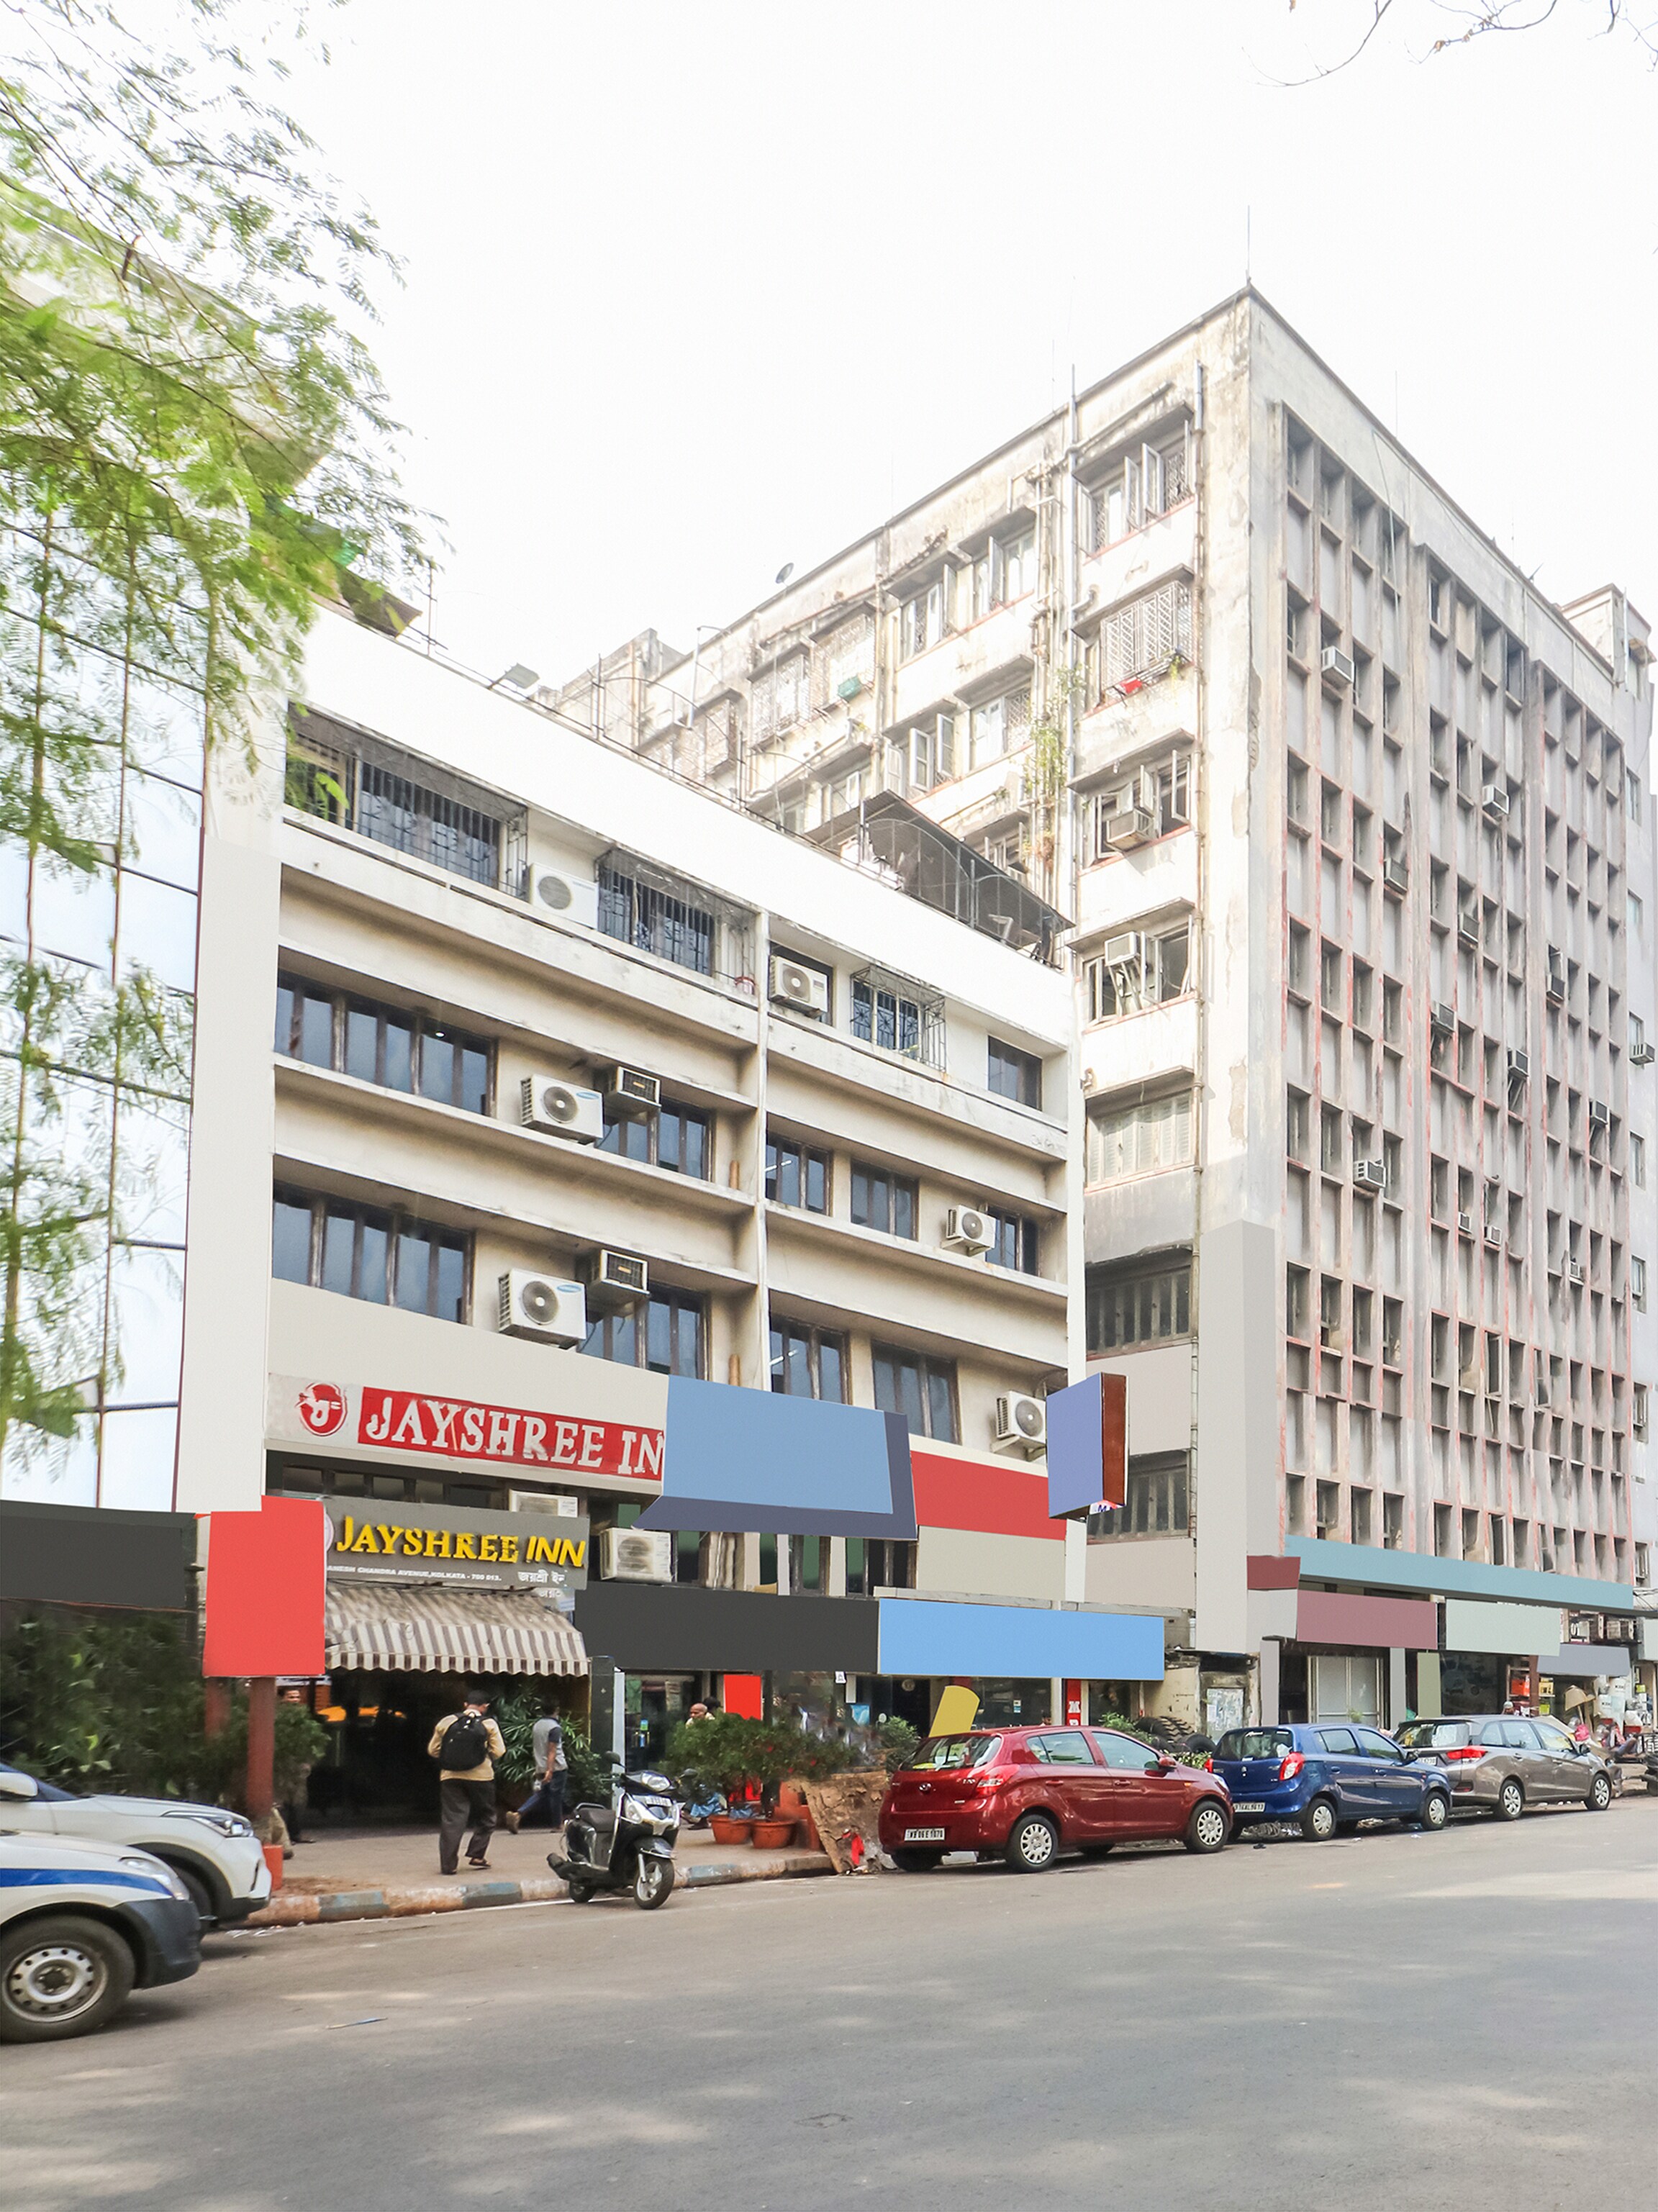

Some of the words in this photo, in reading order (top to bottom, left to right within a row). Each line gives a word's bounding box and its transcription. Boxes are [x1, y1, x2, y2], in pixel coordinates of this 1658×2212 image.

[366, 1397, 605, 1467] JAYSHREE
[336, 1515, 519, 1563] JAYSHREE
[525, 1535, 586, 1568] INN
[357, 1566, 396, 1576] CHANDRA
